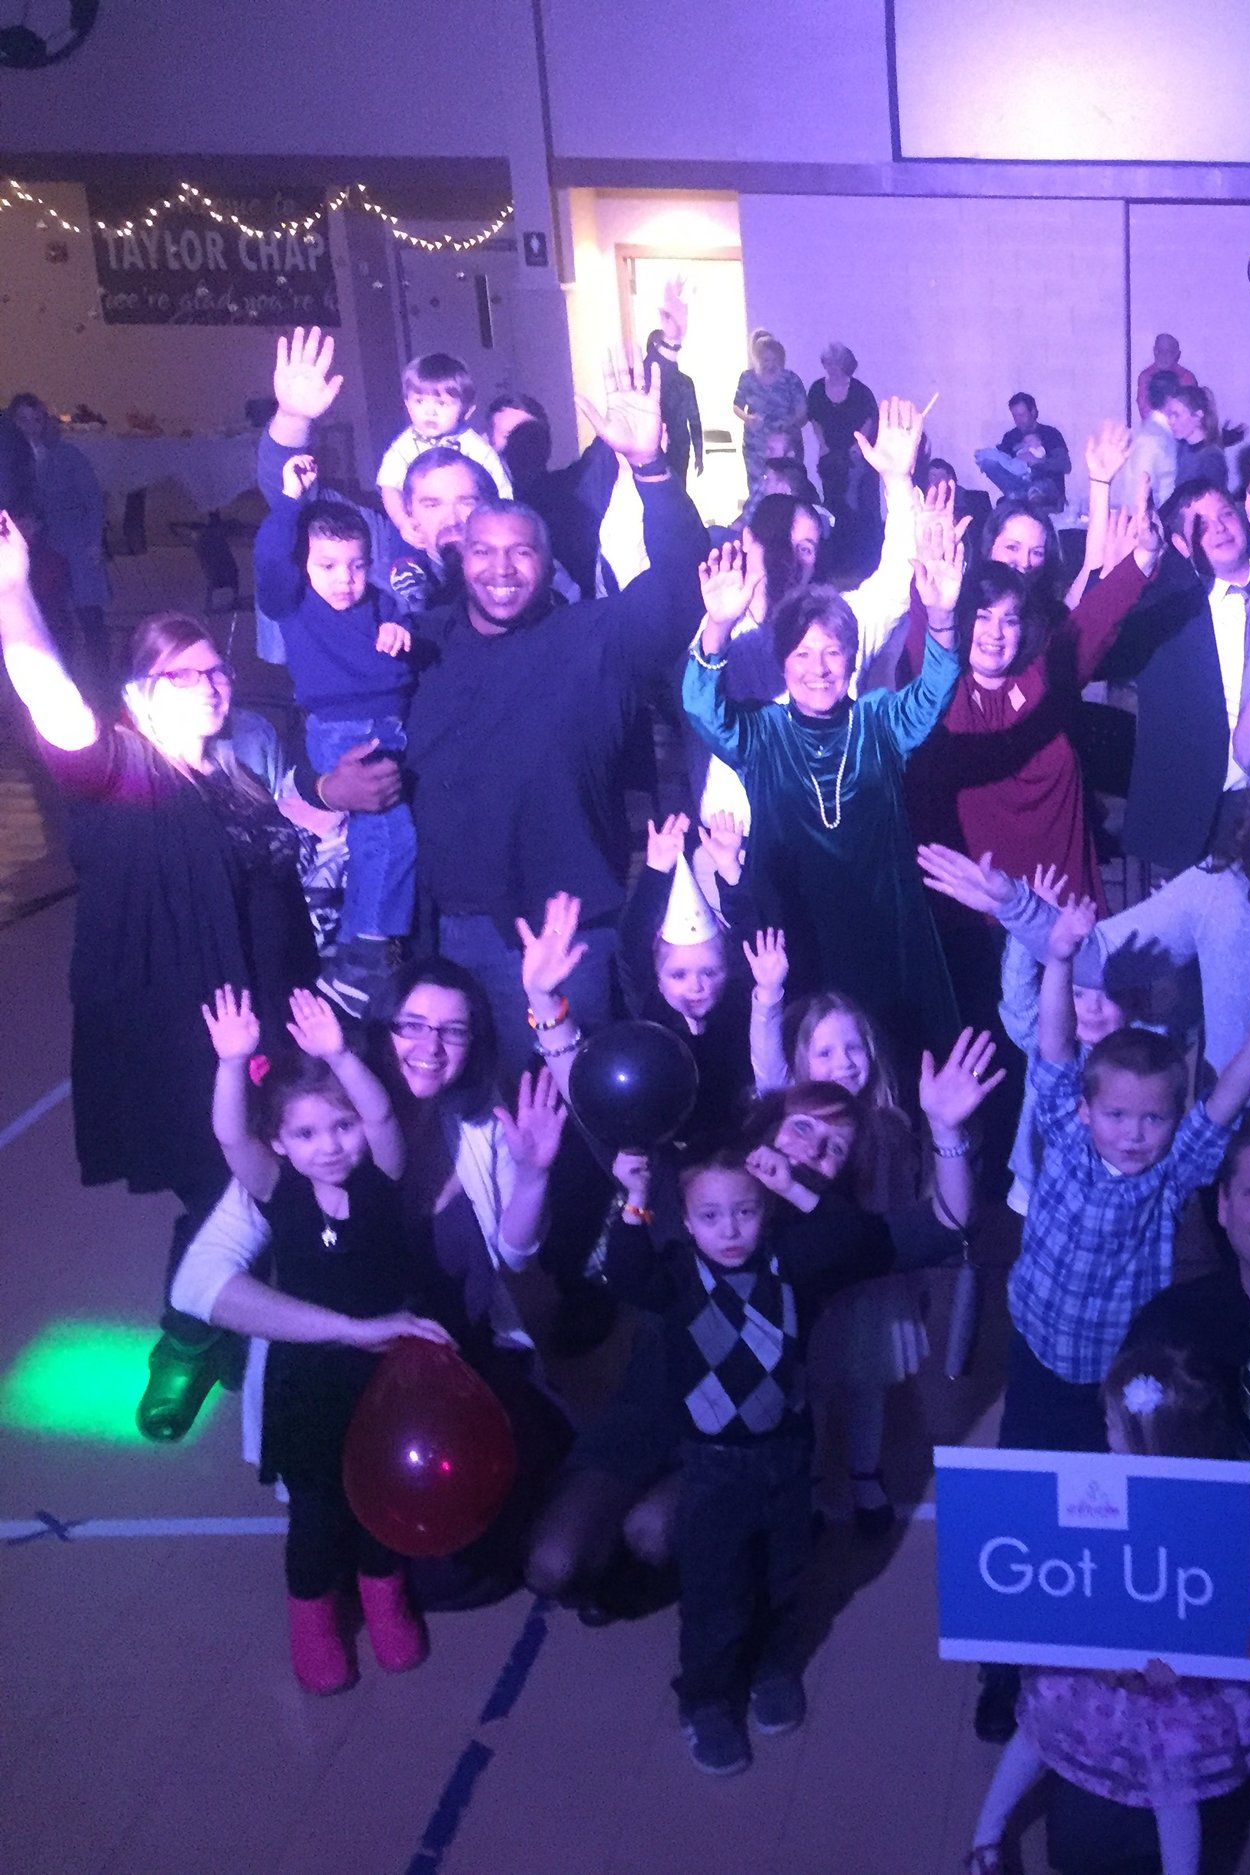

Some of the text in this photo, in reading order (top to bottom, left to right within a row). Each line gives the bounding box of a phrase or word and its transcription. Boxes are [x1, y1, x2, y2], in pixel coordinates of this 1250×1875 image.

[102, 229, 325, 272] TAYLOR CHAP
[979, 1536, 1214, 1619] Got Up
